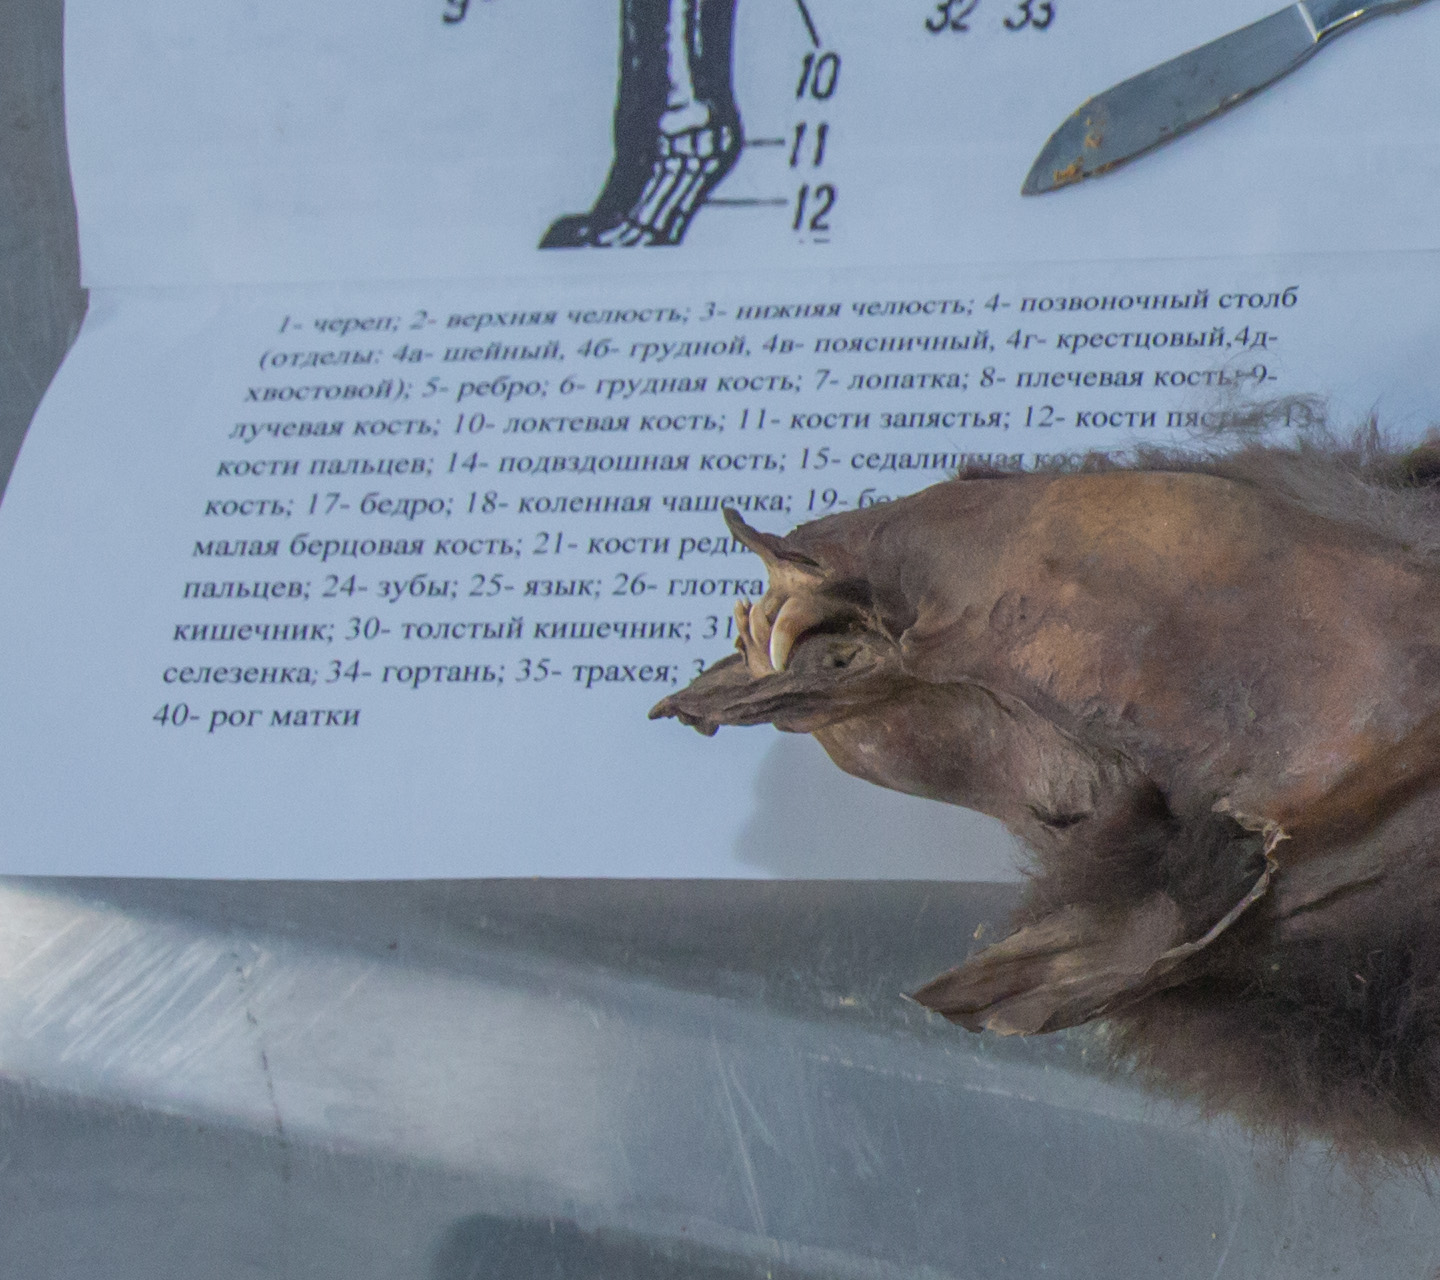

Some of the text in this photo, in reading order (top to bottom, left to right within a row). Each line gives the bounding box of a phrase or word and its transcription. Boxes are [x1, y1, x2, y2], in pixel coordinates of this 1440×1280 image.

[796, 51, 842, 102] 10
[789, 121, 830, 169] 11
[792, 184, 838, 232] 12
[244, 378, 413, 403] хвостовой);
[421, 376, 449, 398] 5-
[455, 374, 549, 404] ребро;
[558, 375, 586, 395] 6-
[595, 376, 709, 401] грудная
[716, 374, 803, 394] кость;
[816, 368, 839, 391] 7-
[846, 372, 970, 392] лопатка;
[979, 366, 1007, 389] 8-
[1015, 370, 1145, 389] плечевая
[228, 420, 345, 445] лучевая
[352, 418, 441, 437] кость;
[454, 412, 496, 435] 10-
[502, 415, 631, 434] локтевая
[638, 414, 726, 434] кость;
[739, 407, 781, 431] 11-
[789, 412, 871, 430] кости
[880, 411, 1011, 432] запястья;
[1024, 404, 1066, 429] 12-
[1074, 410, 1157, 429] кости
[216, 459, 301, 478] кости
[308, 457, 434, 477] пальцев;
[447, 451, 489, 474] 14-
[498, 454, 691, 476] подвздошная
[699, 453, 787, 474] кость;
[800, 446, 842, 471] 15-
[203, 499, 294, 518] кость;
[308, 491, 351, 516] 17-
[359, 491, 454, 522] бедро;
[467, 490, 509, 515] 18-
[517, 495, 653, 515] коленная
[806, 487, 849, 512] 19-
[192, 539, 281, 558] малая
[288, 532, 426, 563] берцовая
[433, 538, 523, 559] кость;
[532, 530, 578, 556] 21-
[587, 536, 671, 555] кости
[182, 580, 312, 602] пальцев;
[321, 573, 368, 599] 24-
[378, 572, 459, 605] зубы;
[468, 572, 515, 598] 25-
[523, 578, 602, 600] язык;
[611, 571, 658, 597] 26-
[172, 623, 335, 644] кишечник;
[344, 615, 391, 641] 30-
[401, 615, 525, 641] толстый
[532, 621, 692, 643] кишечник;
[162, 666, 319, 687] селезенка;
[324, 658, 372, 684] 34-
[381, 664, 506, 691] гортань;
[515, 657, 562, 683] 35-
[571, 664, 679, 690] трахея;
[152, 702, 362, 735] 40- рог матки
